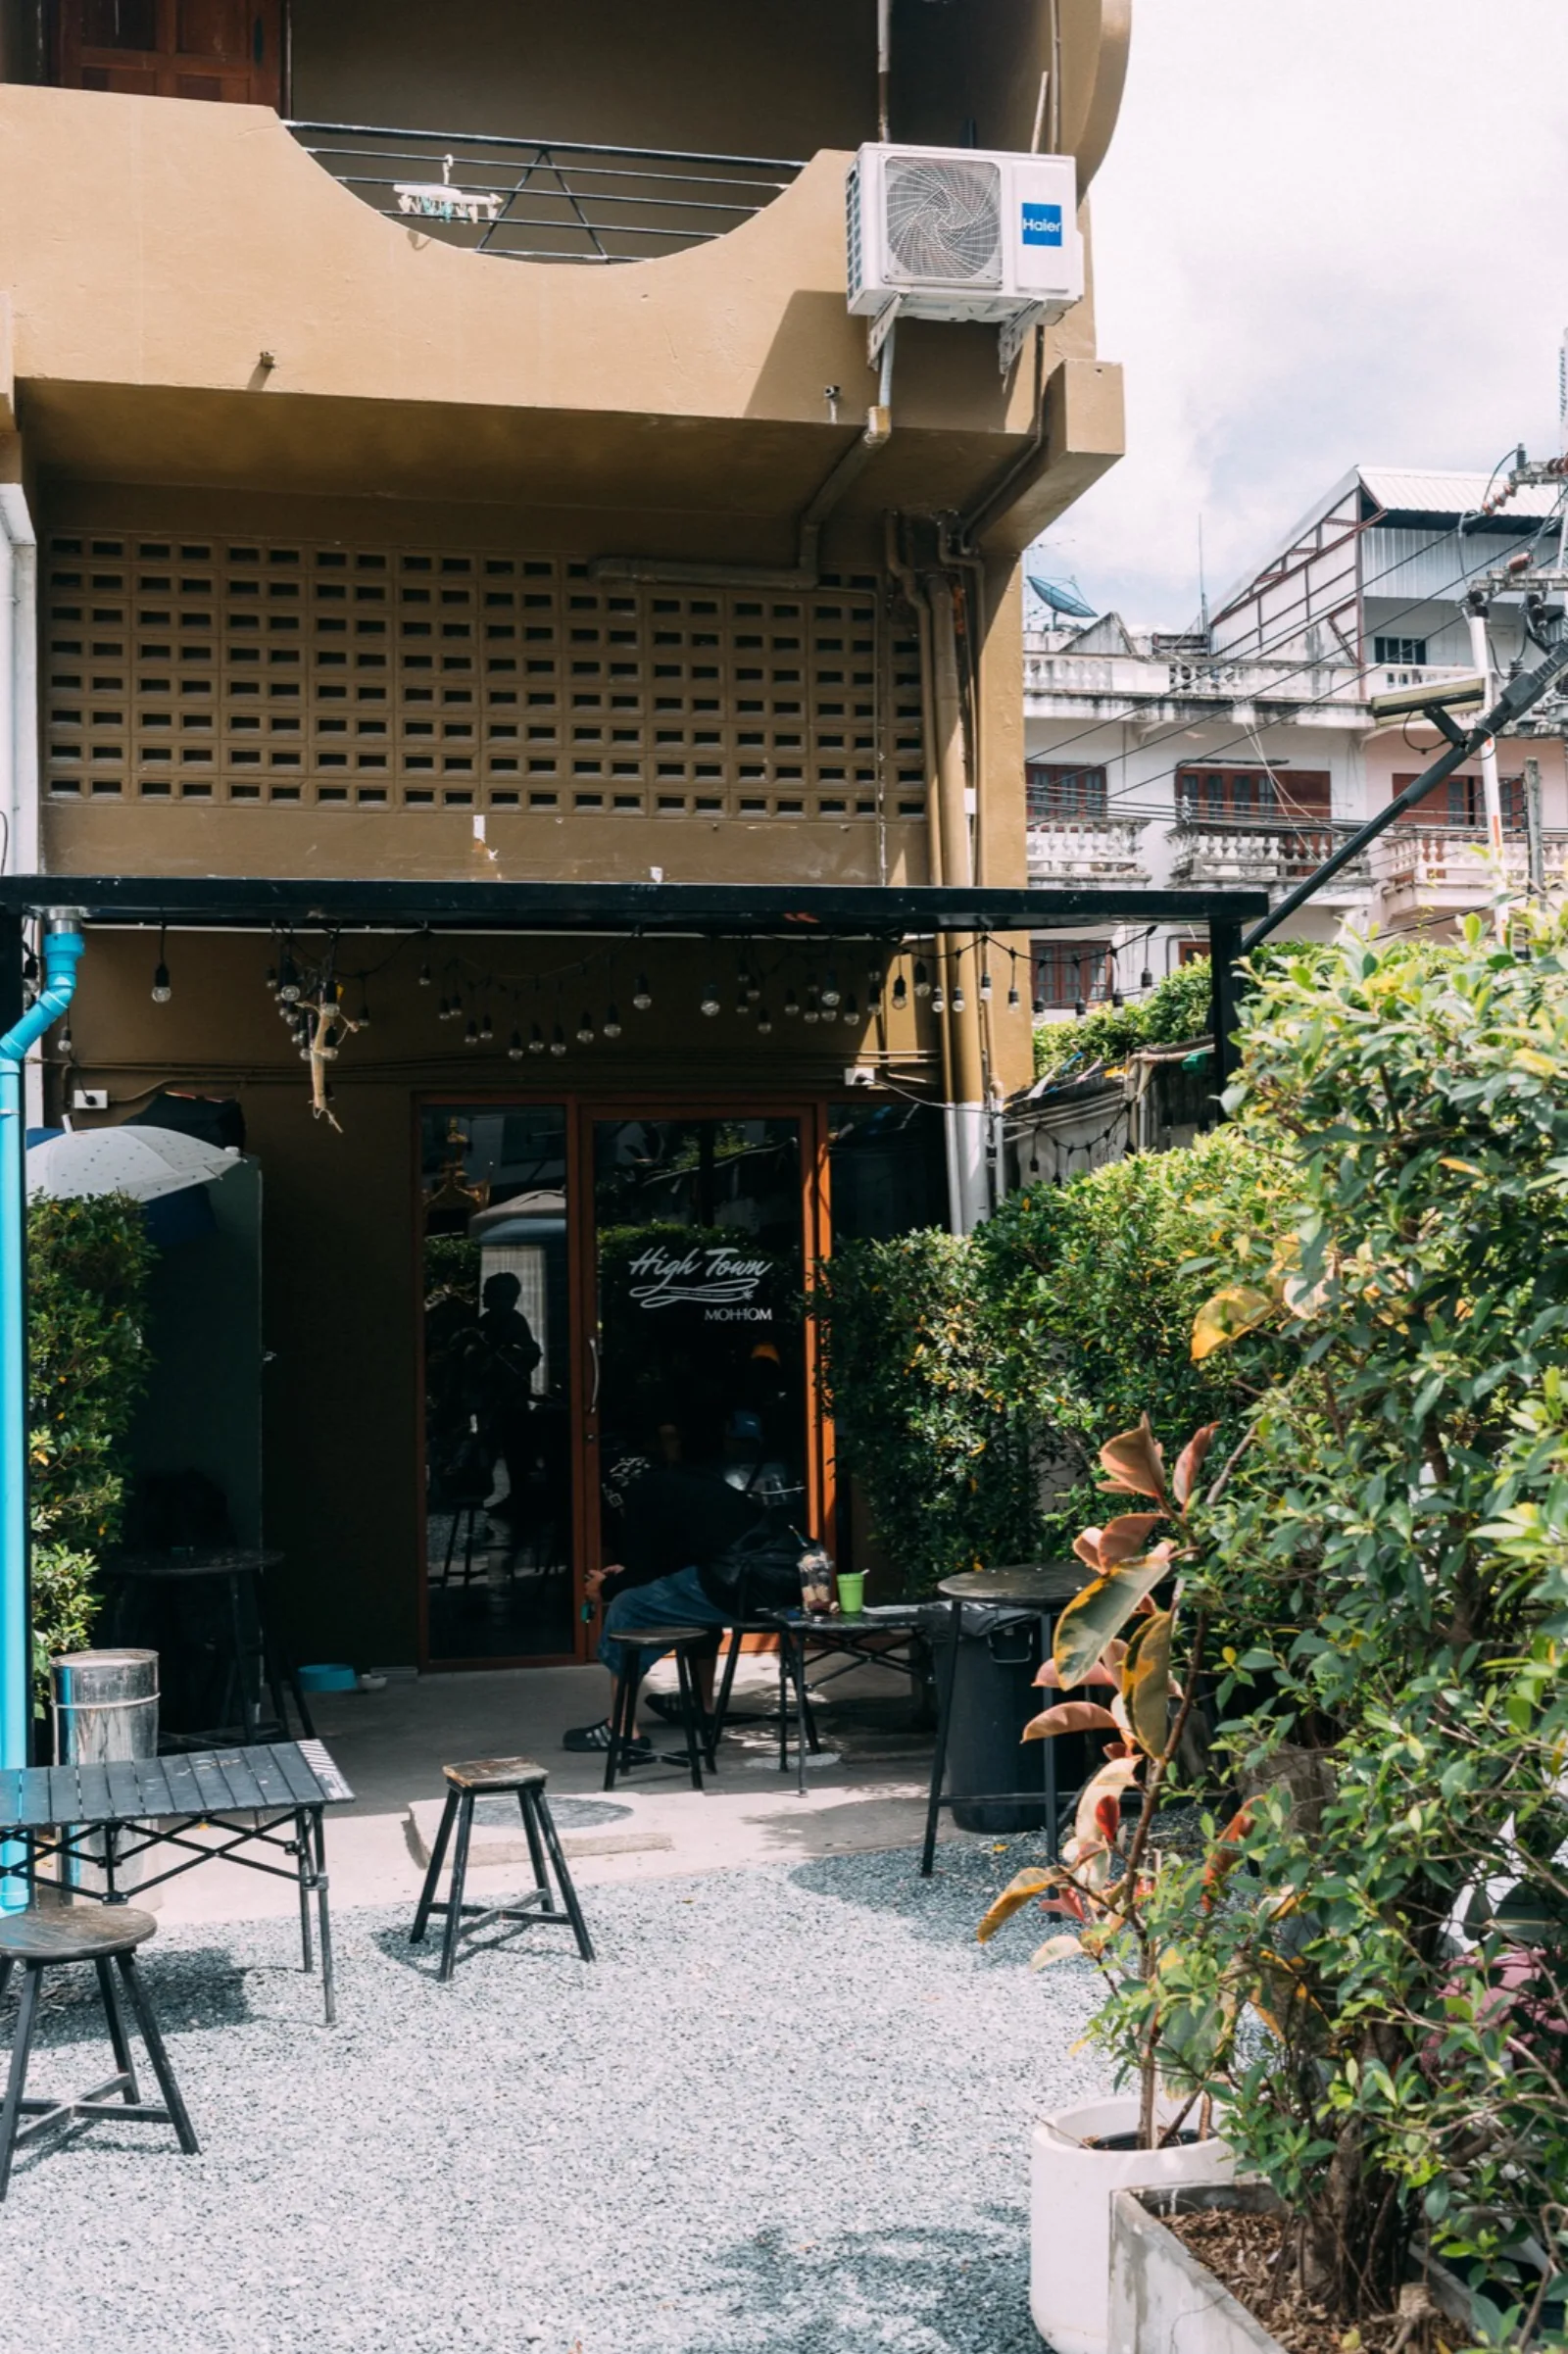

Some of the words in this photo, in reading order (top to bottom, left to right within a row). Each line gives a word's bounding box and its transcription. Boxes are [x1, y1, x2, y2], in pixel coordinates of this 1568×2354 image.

[1023, 218, 1060, 232] Haier
[628, 1246, 703, 1288] High
[705, 1248, 773, 1277] Town
